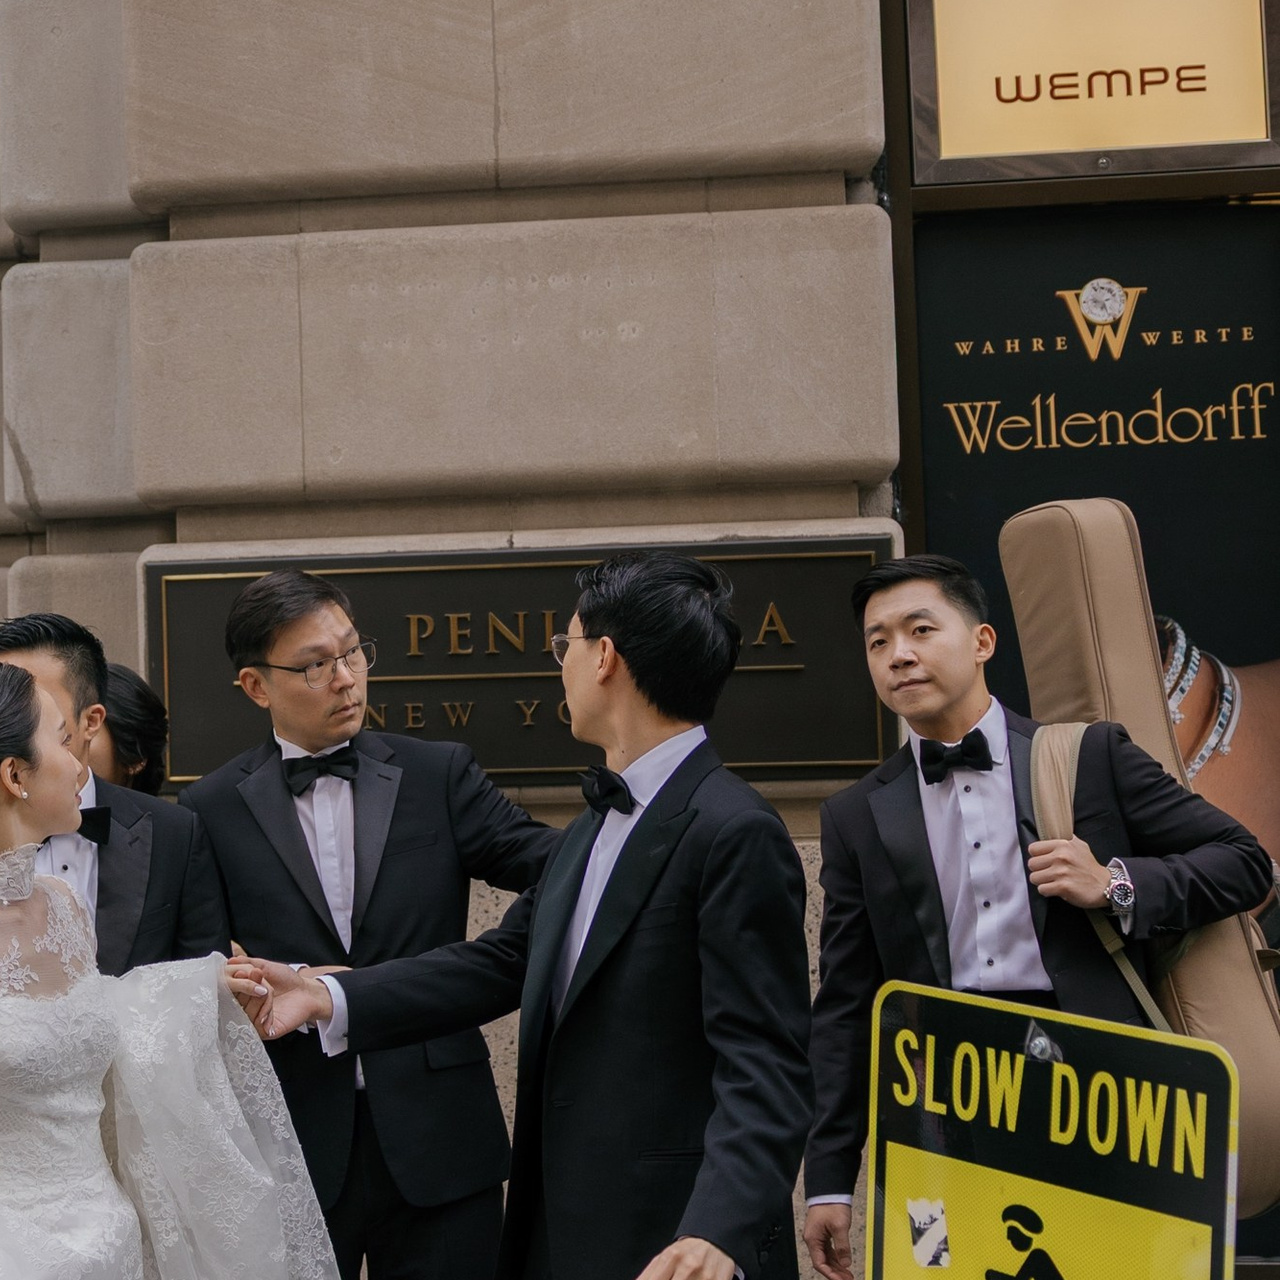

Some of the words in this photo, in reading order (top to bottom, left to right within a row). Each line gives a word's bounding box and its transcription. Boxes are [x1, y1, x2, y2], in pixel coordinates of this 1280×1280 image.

[994, 64, 1208, 104] WEMPE
[954, 336, 1068, 355] WAHRE
[1141, 326, 1255, 346] WERTE
[942, 381, 1275, 455] Wellendorff
[406, 600, 797, 658] PENIA
[363, 701, 475, 730] NEW
[892, 1028, 1026, 1133] SLOW
[1049, 1061, 1208, 1180] DOWN
